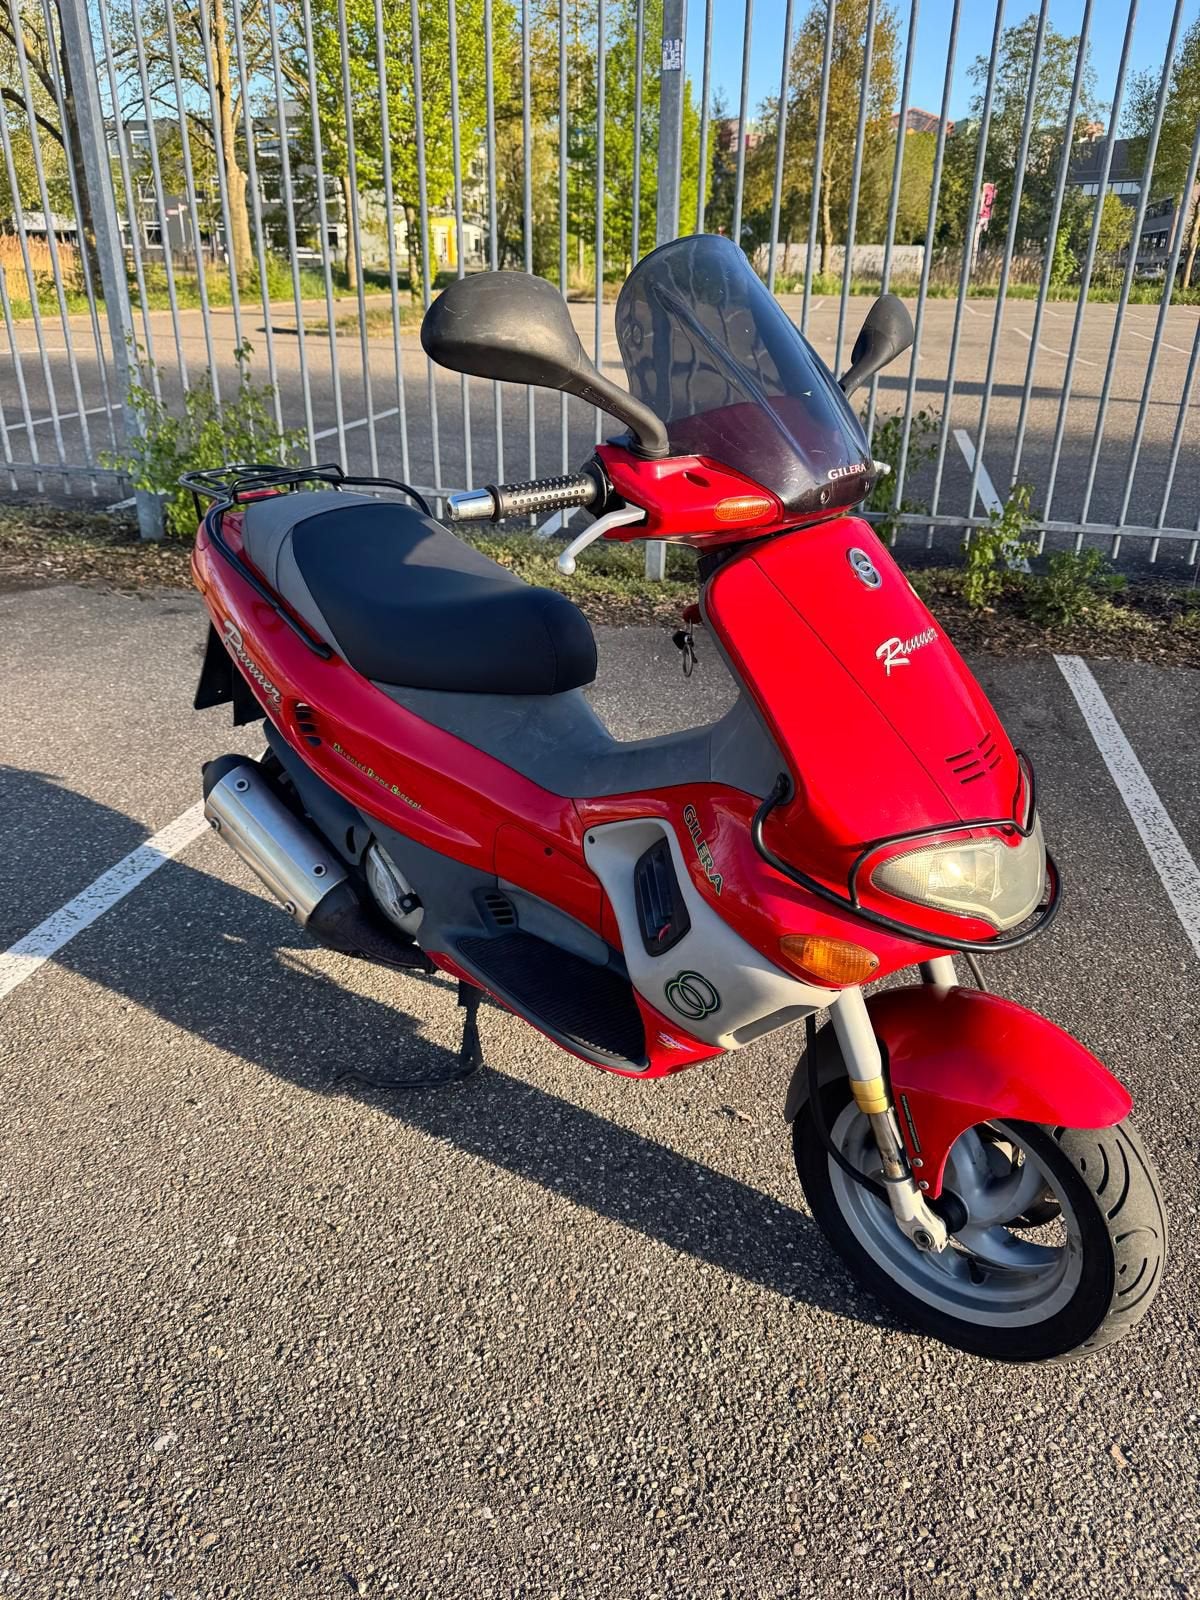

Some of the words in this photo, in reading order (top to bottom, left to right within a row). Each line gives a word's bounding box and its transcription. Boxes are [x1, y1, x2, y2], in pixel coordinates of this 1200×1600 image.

[827, 463, 867, 480] GILERA
[224, 620, 281, 703] Runner
[875, 627, 938, 676] Runner
[391, 785, 422, 811] Concept
[683, 804, 723, 896] GILERA
